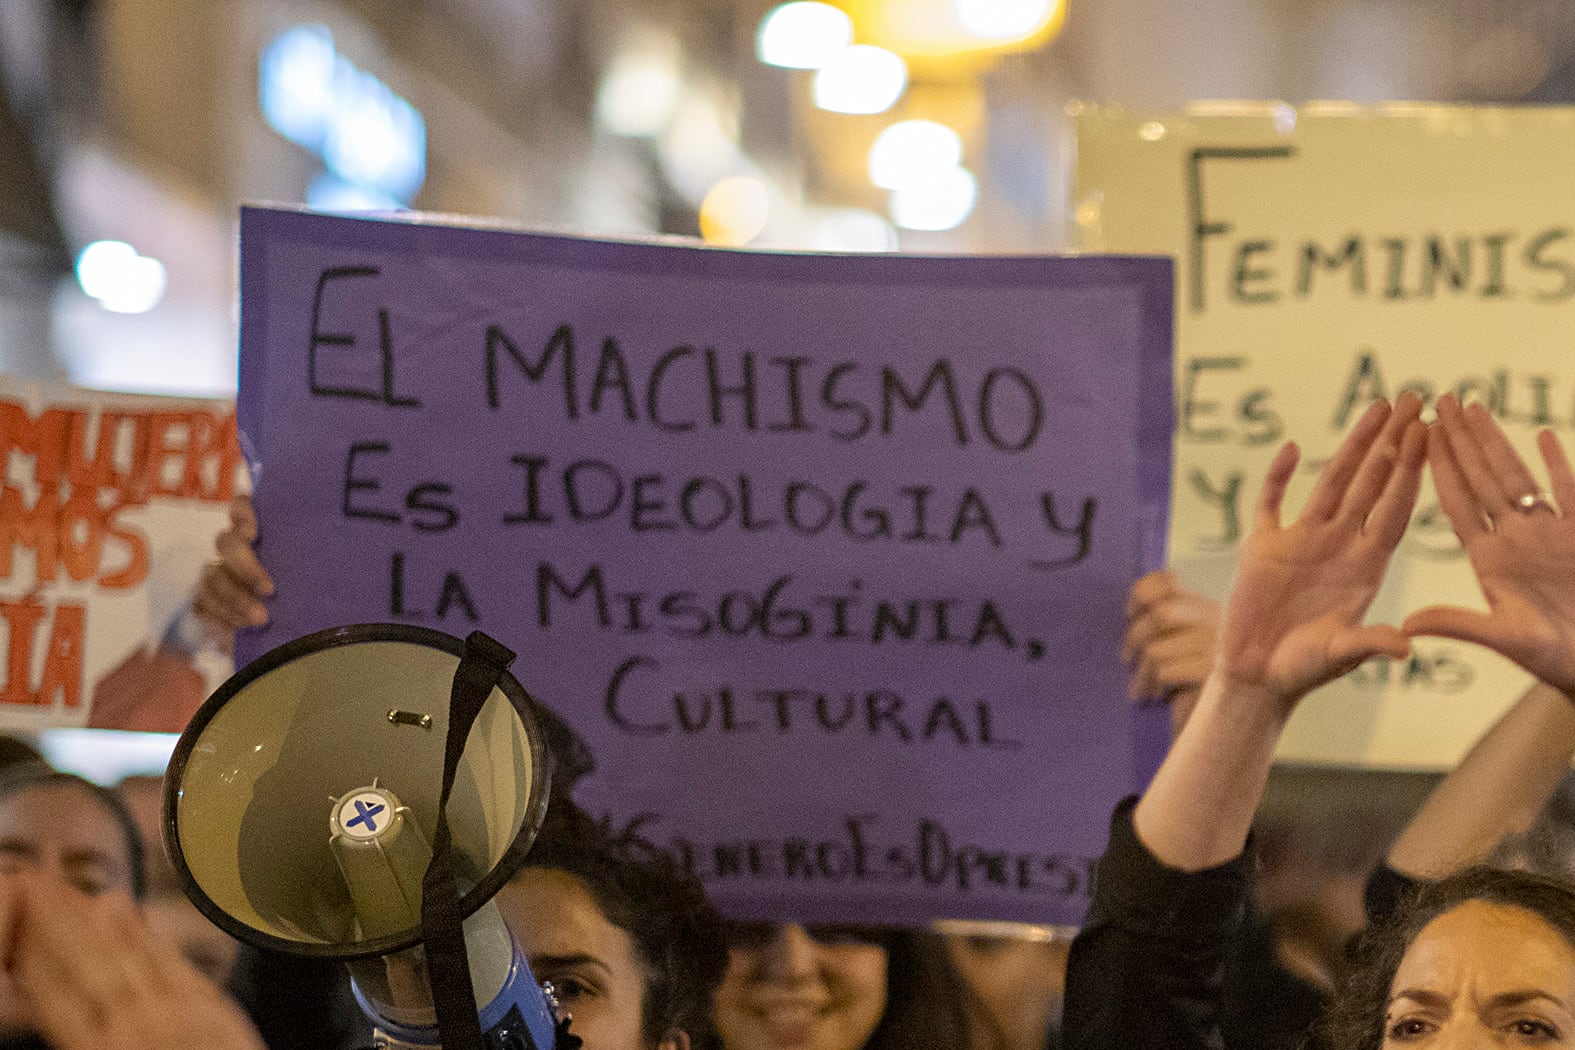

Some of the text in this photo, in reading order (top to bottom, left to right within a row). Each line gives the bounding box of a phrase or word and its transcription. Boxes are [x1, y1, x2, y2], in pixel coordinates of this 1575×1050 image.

[308, 264, 1044, 453] EL MACHISMO
[502, 454, 1002, 548] IDEOLOGIA
[391, 552, 480, 623] LA
[604, 655, 1024, 751] CULTURAL
